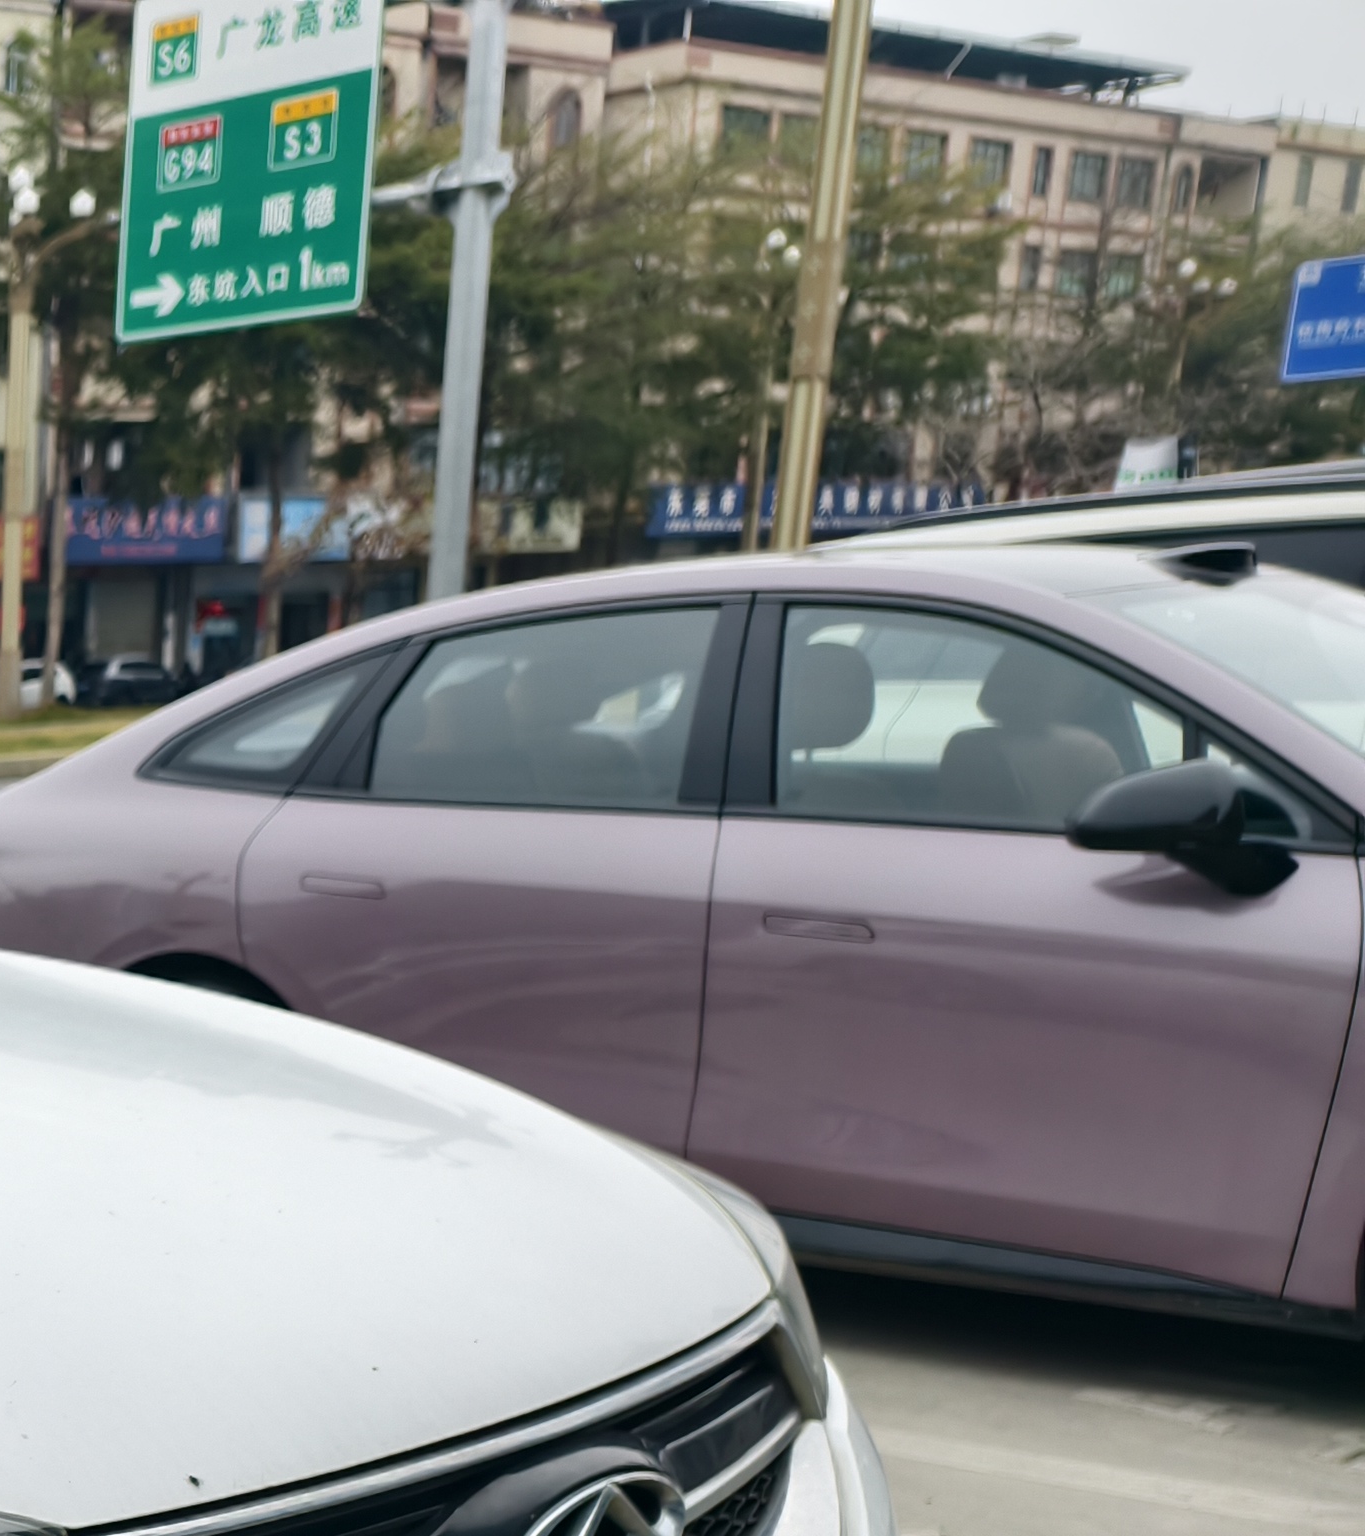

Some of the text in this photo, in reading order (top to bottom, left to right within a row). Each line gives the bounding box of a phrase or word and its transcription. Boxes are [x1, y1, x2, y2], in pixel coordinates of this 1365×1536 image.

[157, 38, 192, 77] S6
[283, 120, 322, 160] S3
[164, 141, 214, 183] G94
[149, 203, 223, 258] 广州
[258, 183, 337, 238] 顺德
